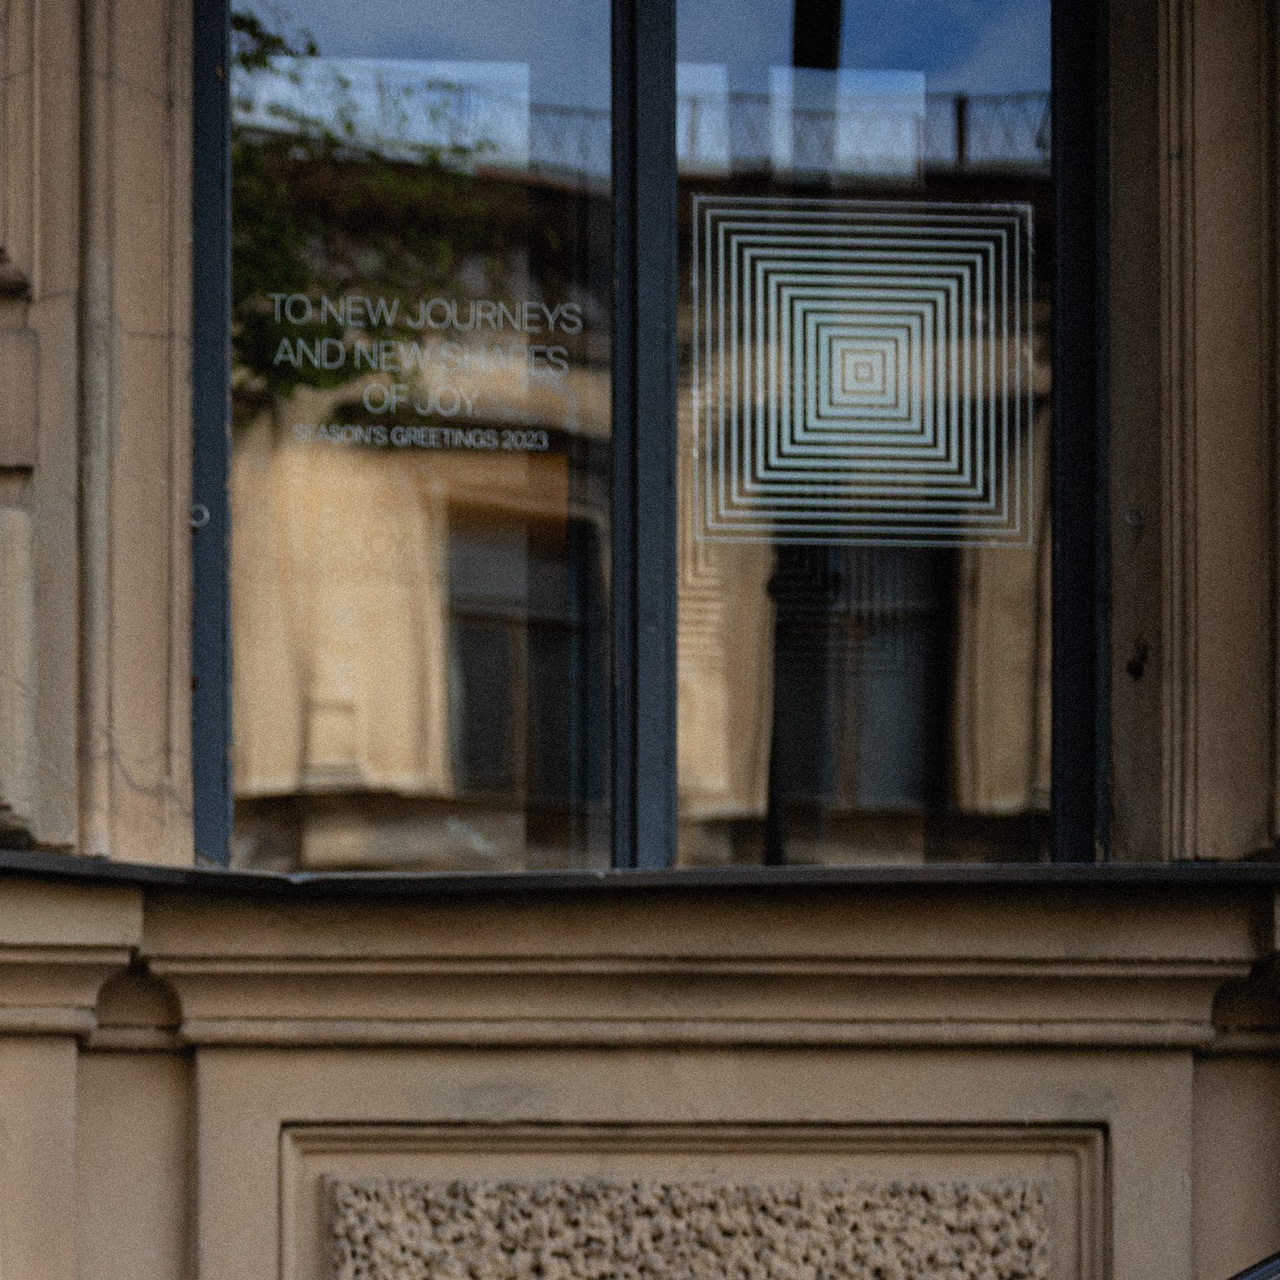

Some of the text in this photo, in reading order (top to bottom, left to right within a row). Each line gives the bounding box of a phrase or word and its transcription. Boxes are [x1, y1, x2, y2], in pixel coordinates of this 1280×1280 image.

[268, 293, 584, 335] TO NEW JOURNEYS
[273, 338, 570, 378] AND NEW SHAPES
[363, 381, 409, 415] OF
[391, 426, 498, 449] GREETINGS
[502, 429, 550, 451] 2023
